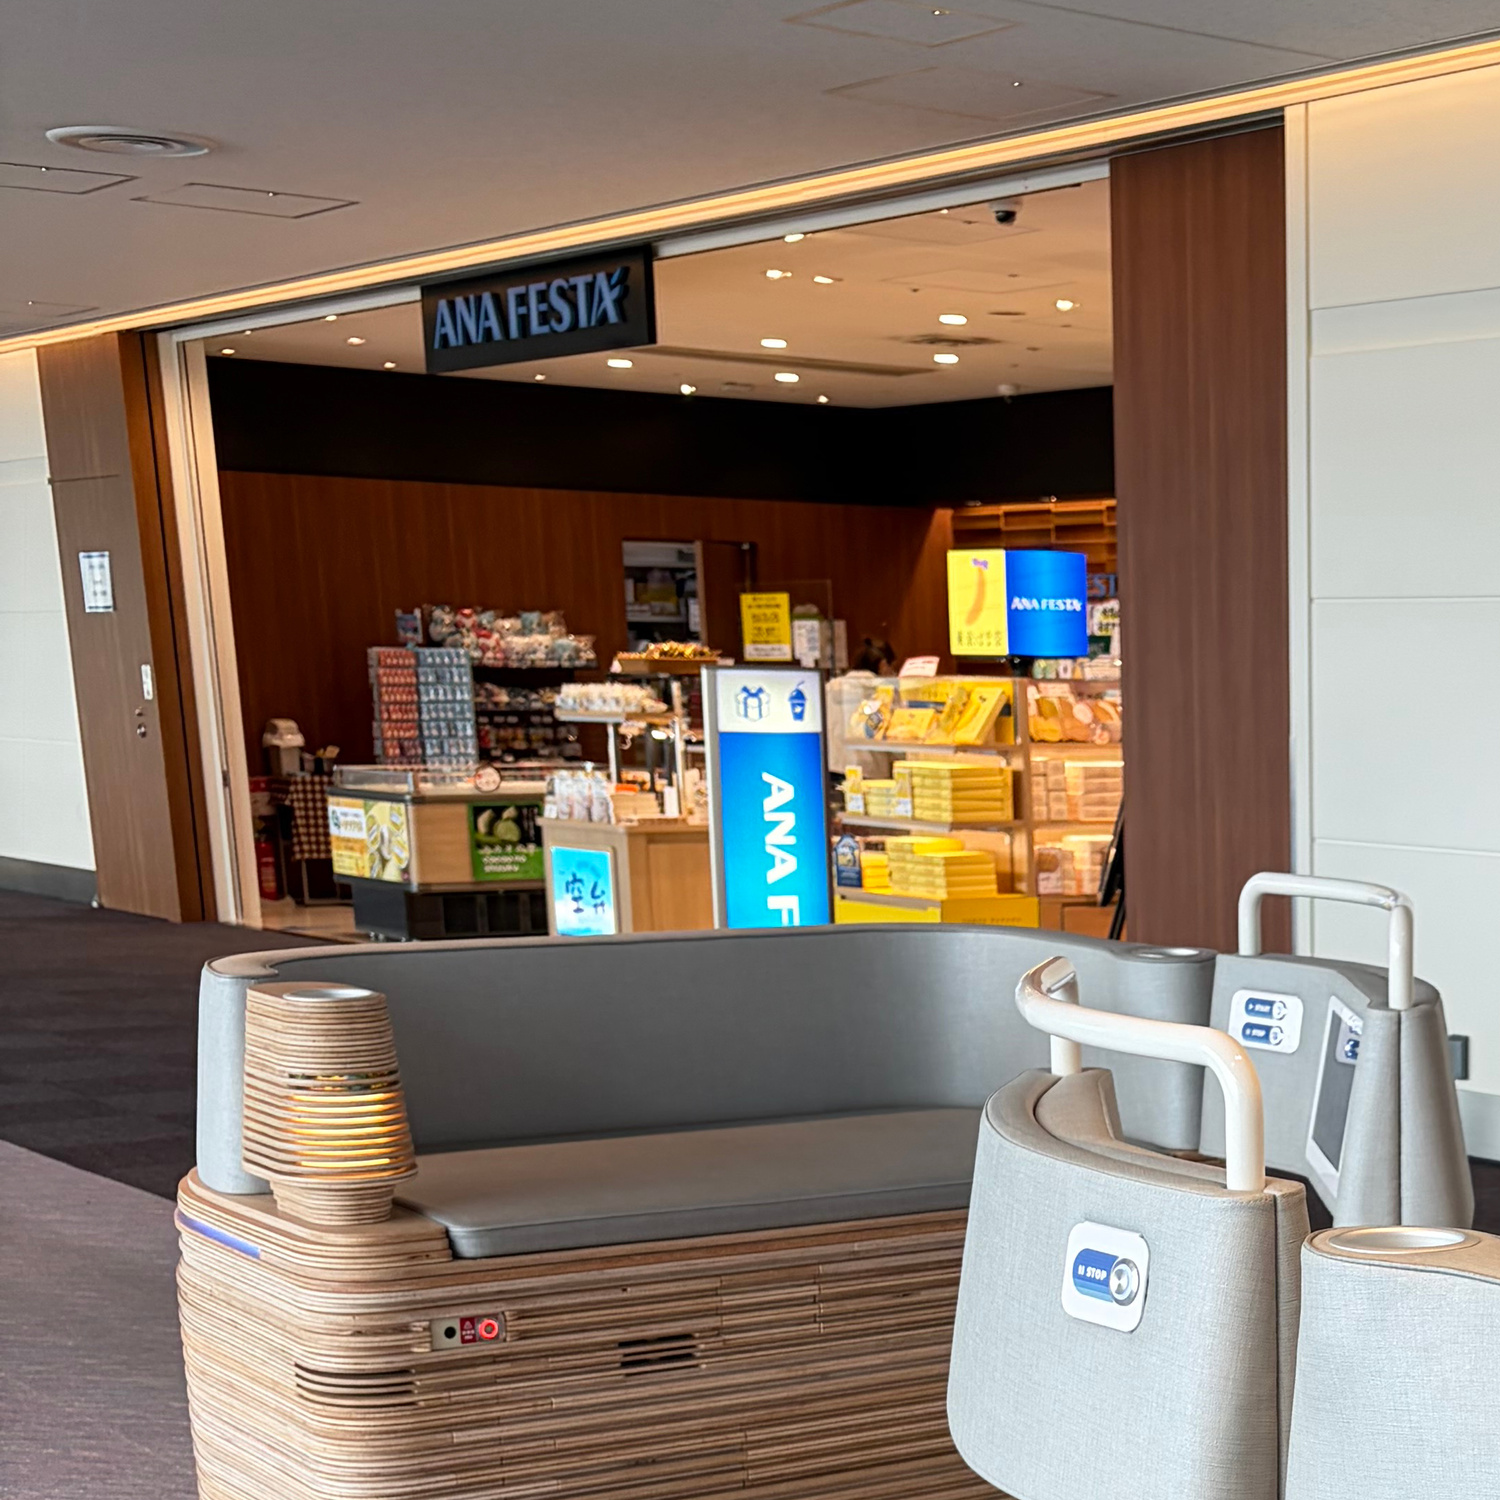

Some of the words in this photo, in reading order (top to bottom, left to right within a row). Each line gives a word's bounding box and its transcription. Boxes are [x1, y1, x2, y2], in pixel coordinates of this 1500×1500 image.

[433, 291, 503, 350] ANA
[507, 266, 627, 340] FESTA
[1011, 596, 1040, 611] ANA
[1041, 598, 1082, 613] FESTA
[761, 771, 798, 885] ANA
[1086, 1266, 1108, 1281] STOP
